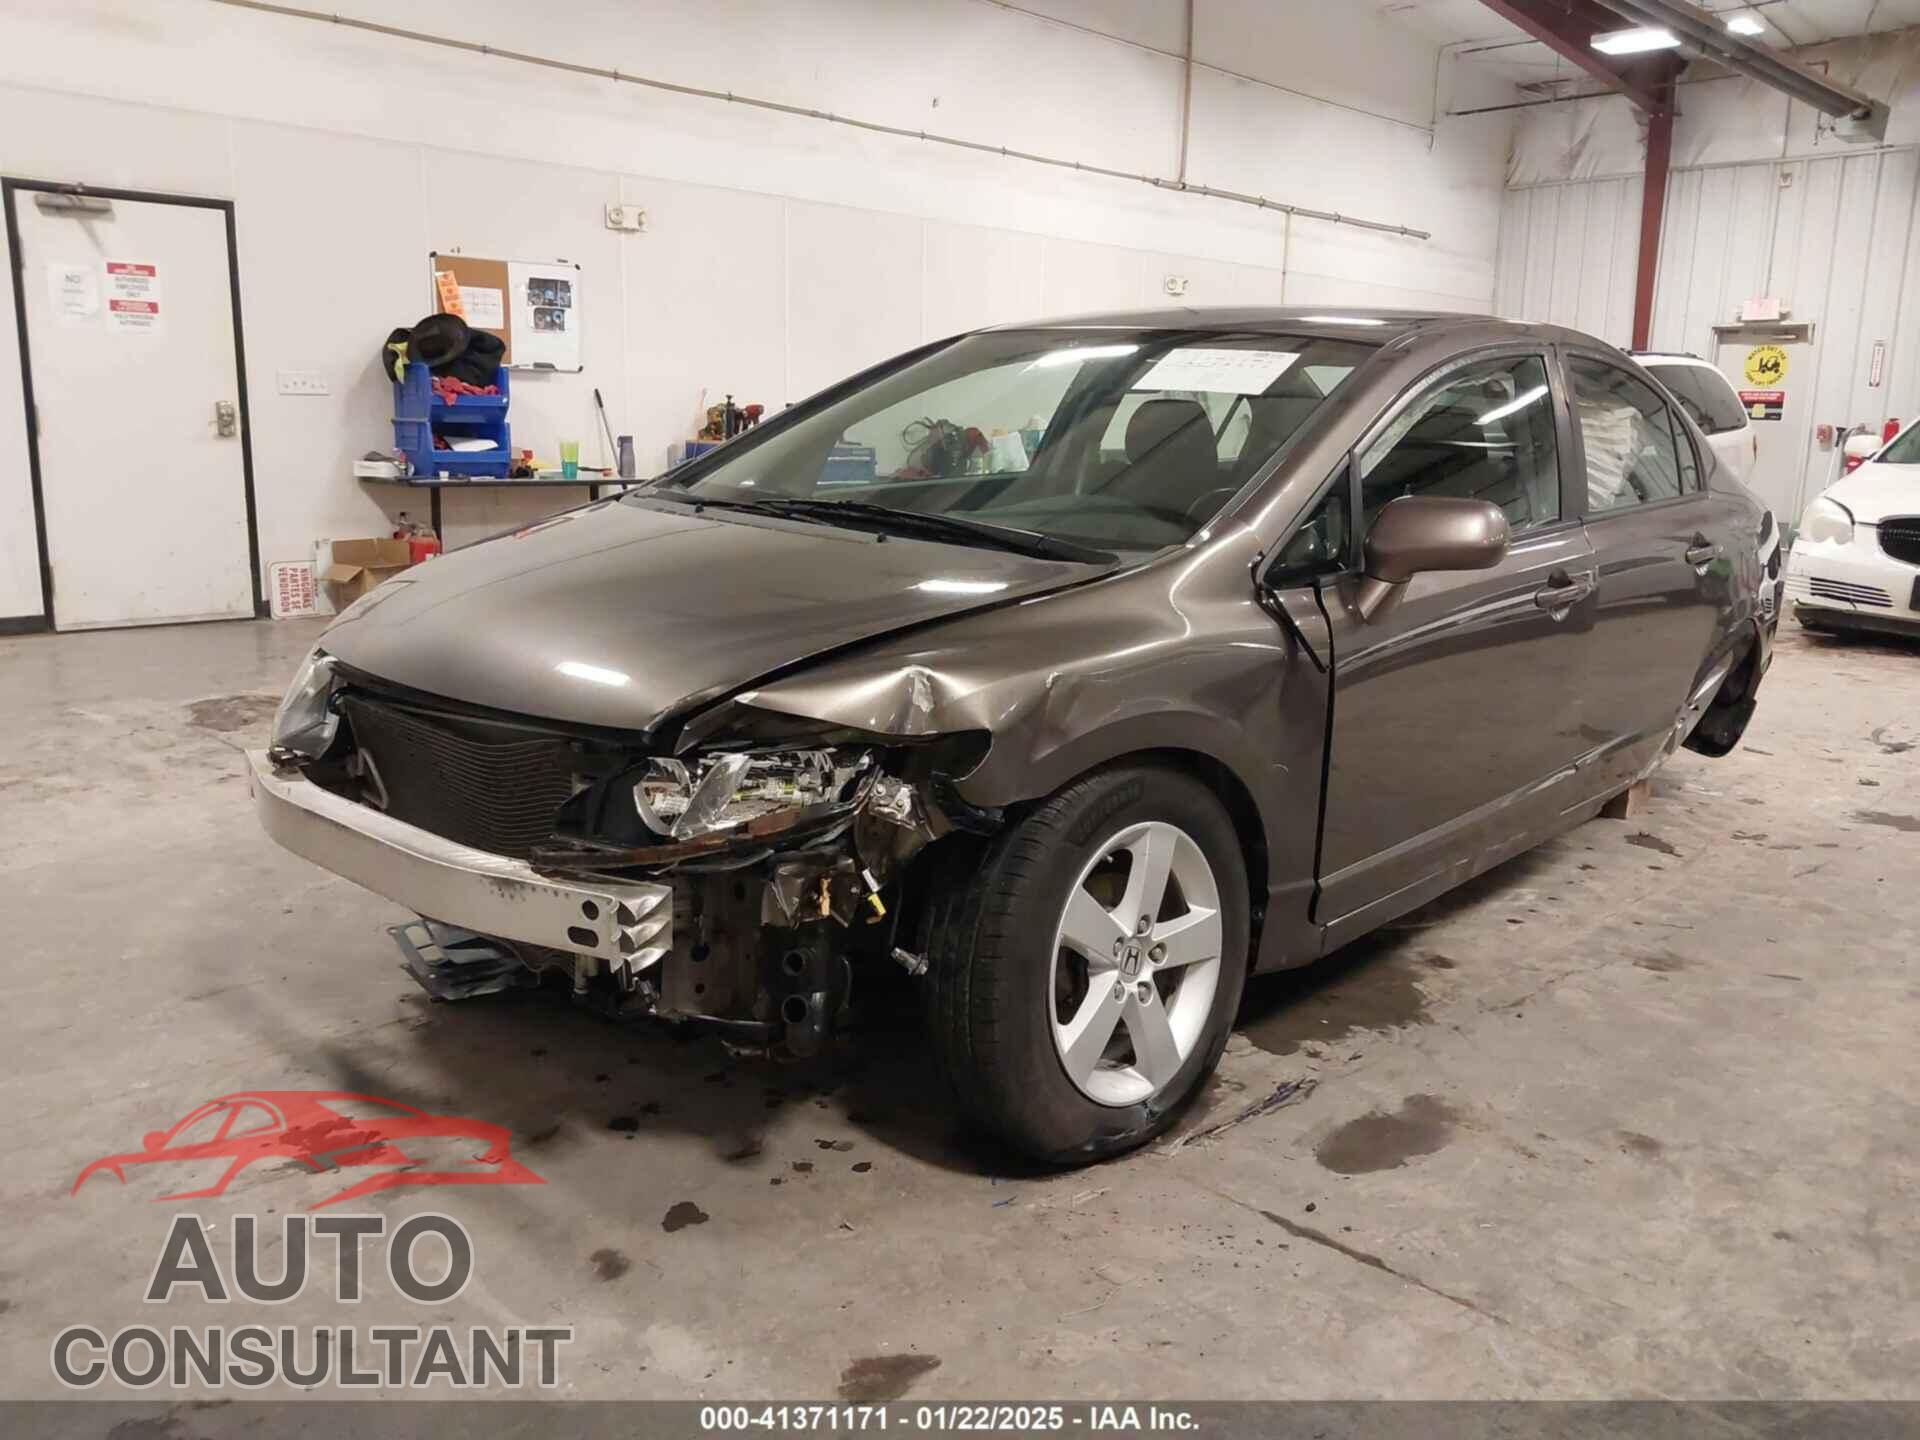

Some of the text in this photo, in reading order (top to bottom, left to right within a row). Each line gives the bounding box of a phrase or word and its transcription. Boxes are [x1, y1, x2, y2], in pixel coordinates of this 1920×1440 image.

[278, 567, 290, 612] VENDIERON
[289, 567, 301, 610] PARTES SE
[300, 567, 312, 609] NINGUNAS
